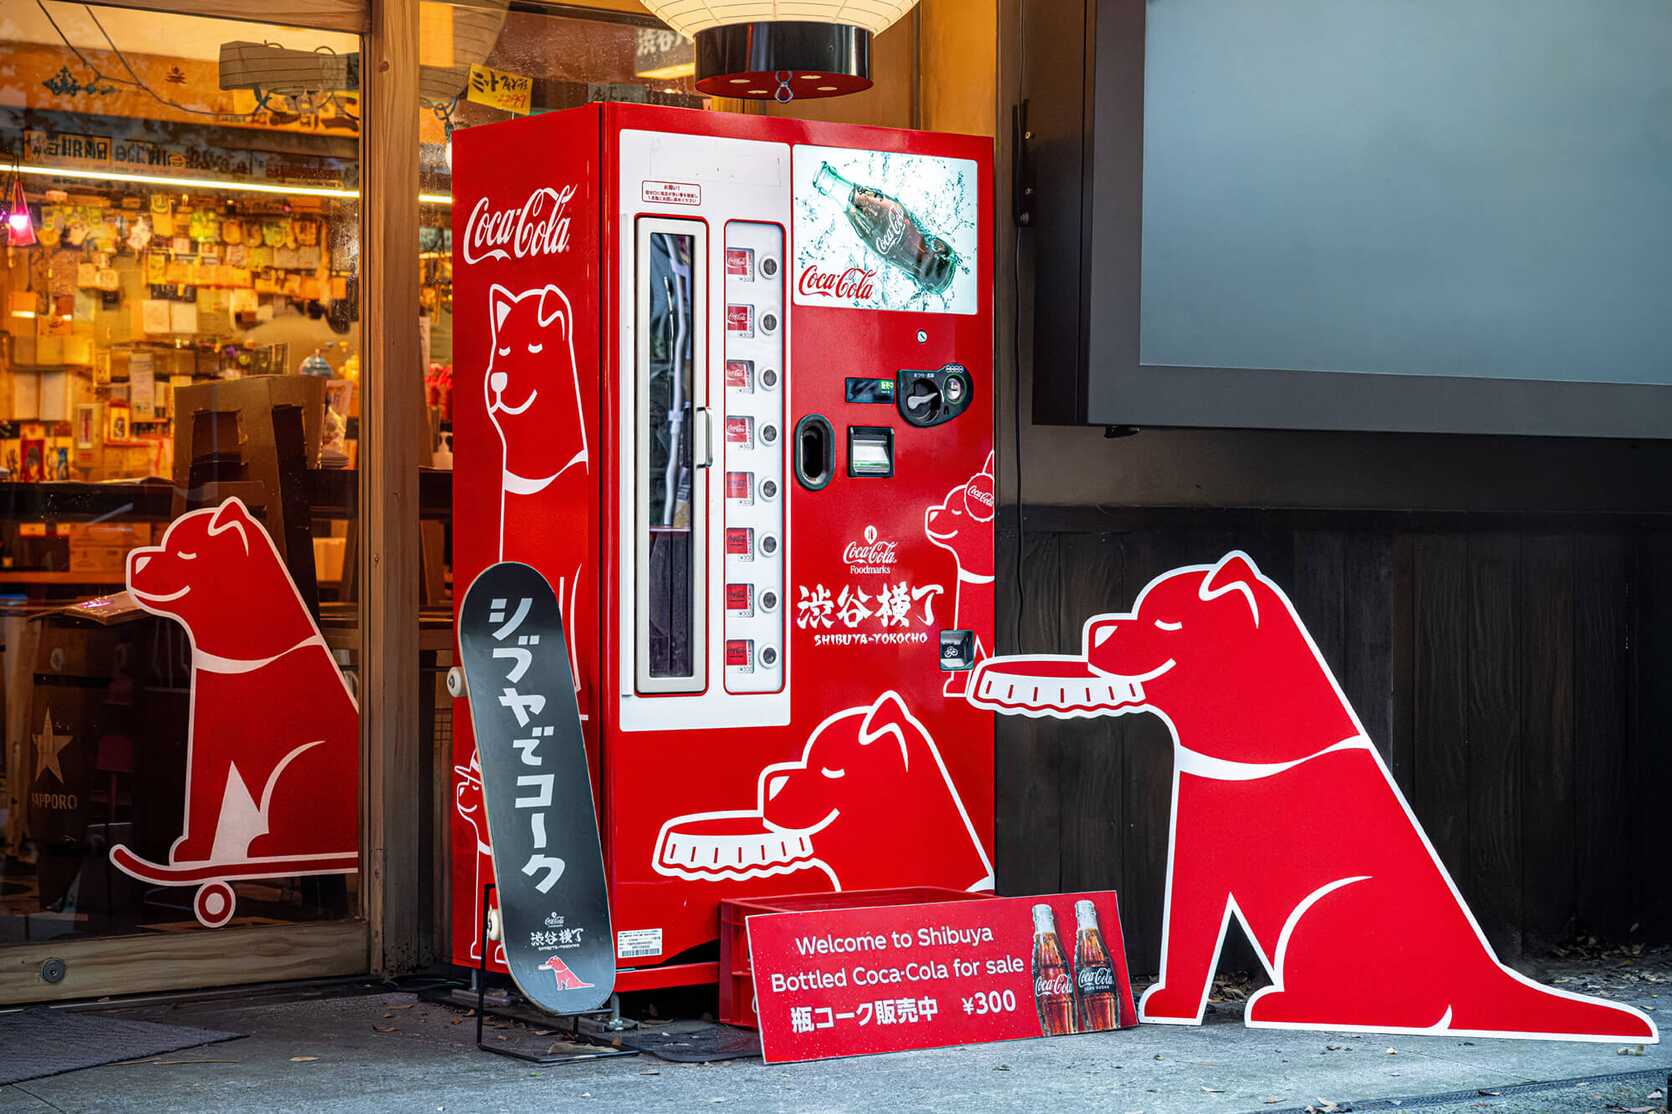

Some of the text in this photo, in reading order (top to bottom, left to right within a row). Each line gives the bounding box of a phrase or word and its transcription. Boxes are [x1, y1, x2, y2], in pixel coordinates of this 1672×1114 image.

[463, 183, 578, 265] Coca-Cola
[876, 207, 905, 254] Coca-Cola
[798, 264, 878, 300] Coca-Cola
[843, 541, 898, 565] Coca-Cola
[850, 565, 891, 575] Foodmarks
[797, 581, 945, 629] 渋谷横丁
[488, 597, 566, 894] シブヤでコーク
[796, 926, 994, 956] Welcome to Shibuya
[771, 968, 847, 993] Bottled
[953, 959, 981, 978] for
[986, 954, 1025, 975] sale
[1078, 967, 1115, 988] Coca-Cola
[791, 989, 1017, 1035] 瓶コーク販売中 ¥300
